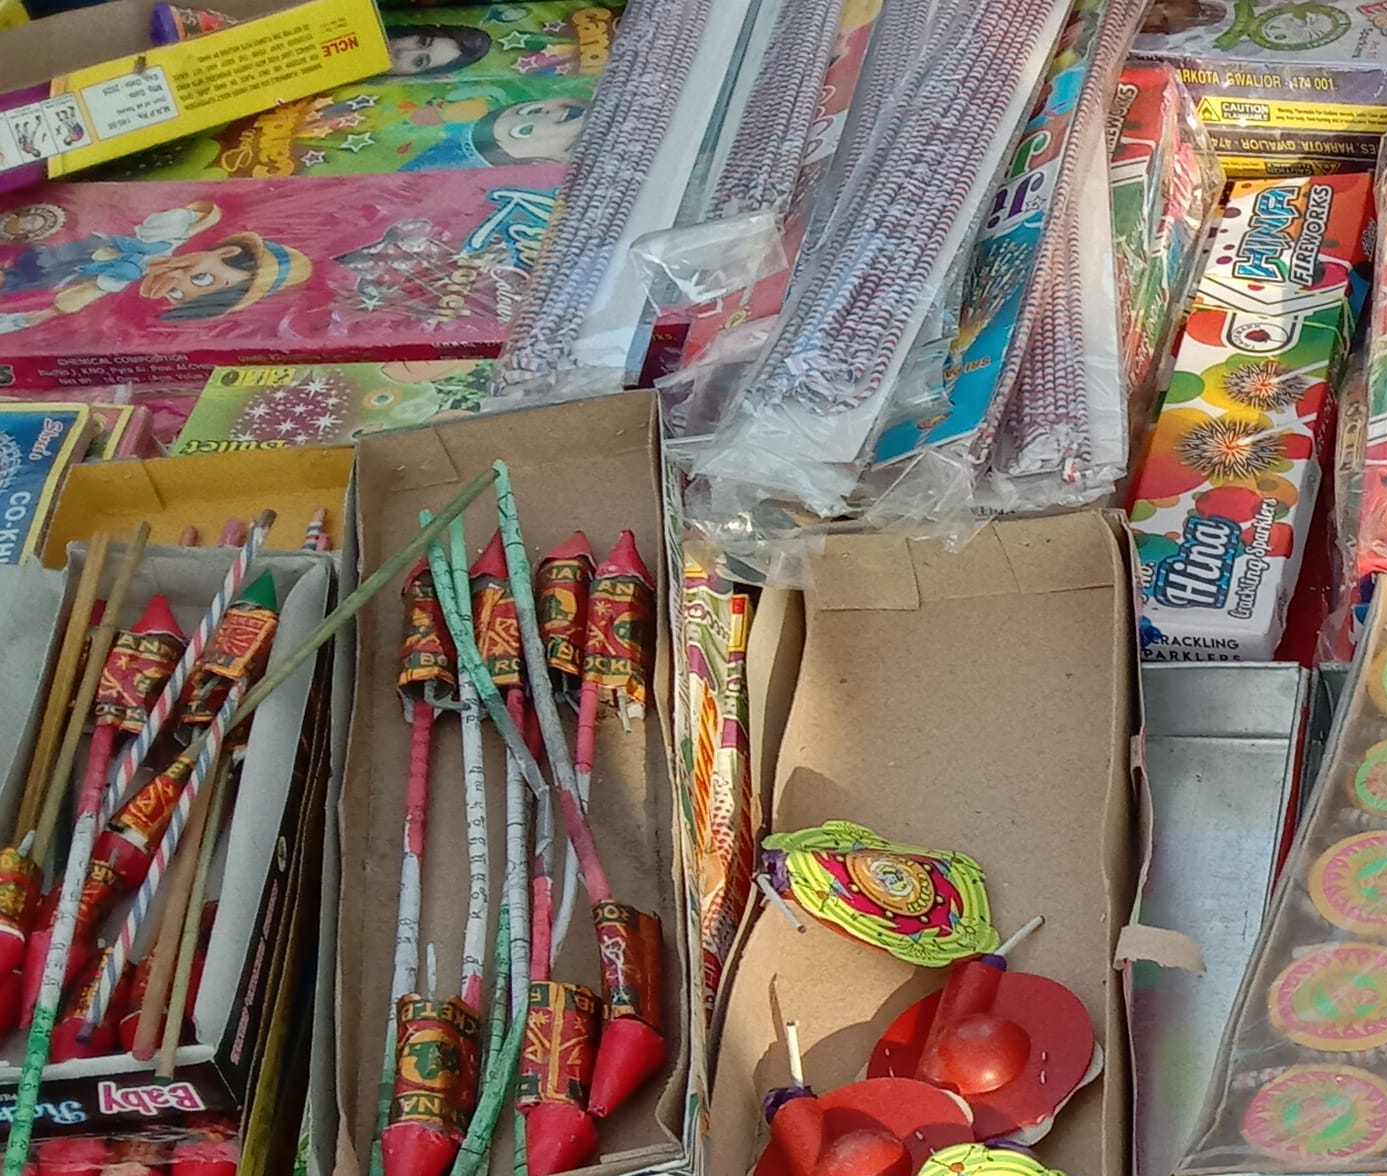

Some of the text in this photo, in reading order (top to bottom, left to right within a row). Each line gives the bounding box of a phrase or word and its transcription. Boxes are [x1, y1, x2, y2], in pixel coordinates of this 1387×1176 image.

[320, 35, 359, 58] NCLE
[1225, 72, 1282, 89] GWALIOR
[1222, 102, 1268, 113] CAUTION
[1233, 187, 1301, 282] HINA
[1290, 184, 1332, 288] FIREWORKS
[1160, 520, 1239, 608] Hina
[98, 1080, 205, 1117] Baby
